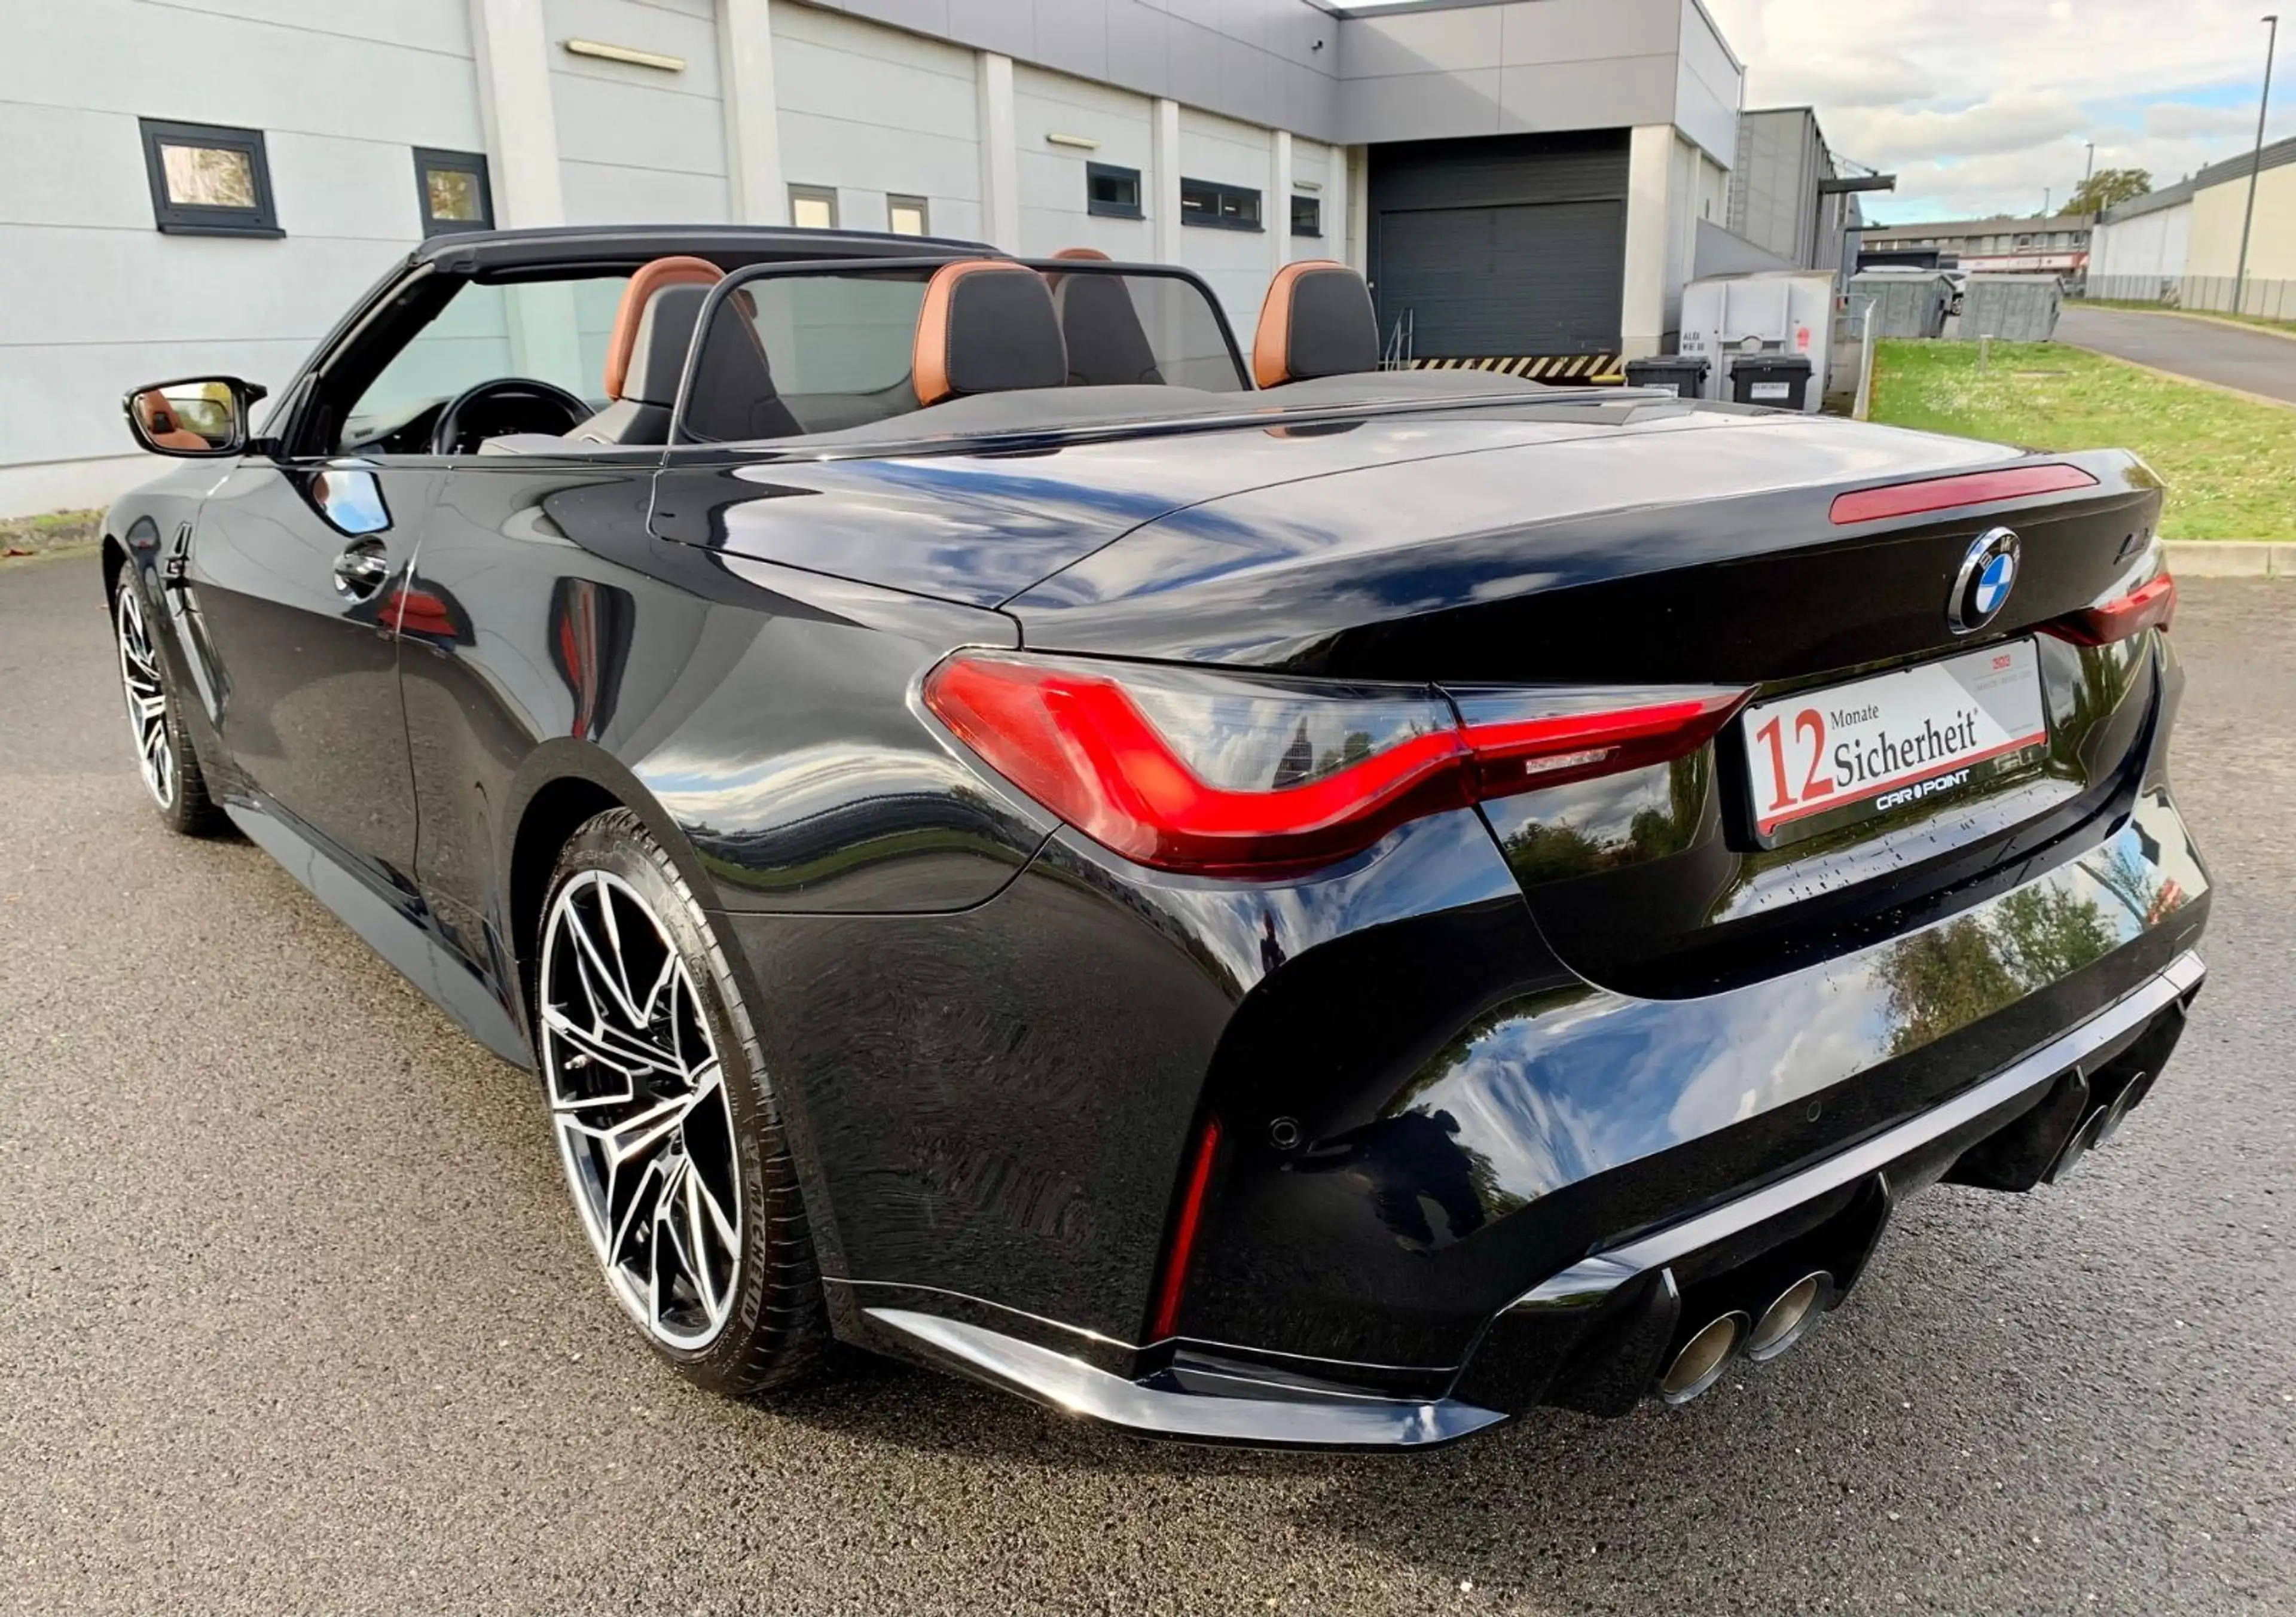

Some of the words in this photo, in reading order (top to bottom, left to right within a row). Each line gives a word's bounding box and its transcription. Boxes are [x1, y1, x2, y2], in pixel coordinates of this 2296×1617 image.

[1756, 709, 1834, 811] 12
[1831, 704, 1879, 730] Monate
[1876, 788, 1913, 810] CAR
[1922, 769, 1970, 795] POINT
[744, 1180, 765, 1323] MICHELIN
